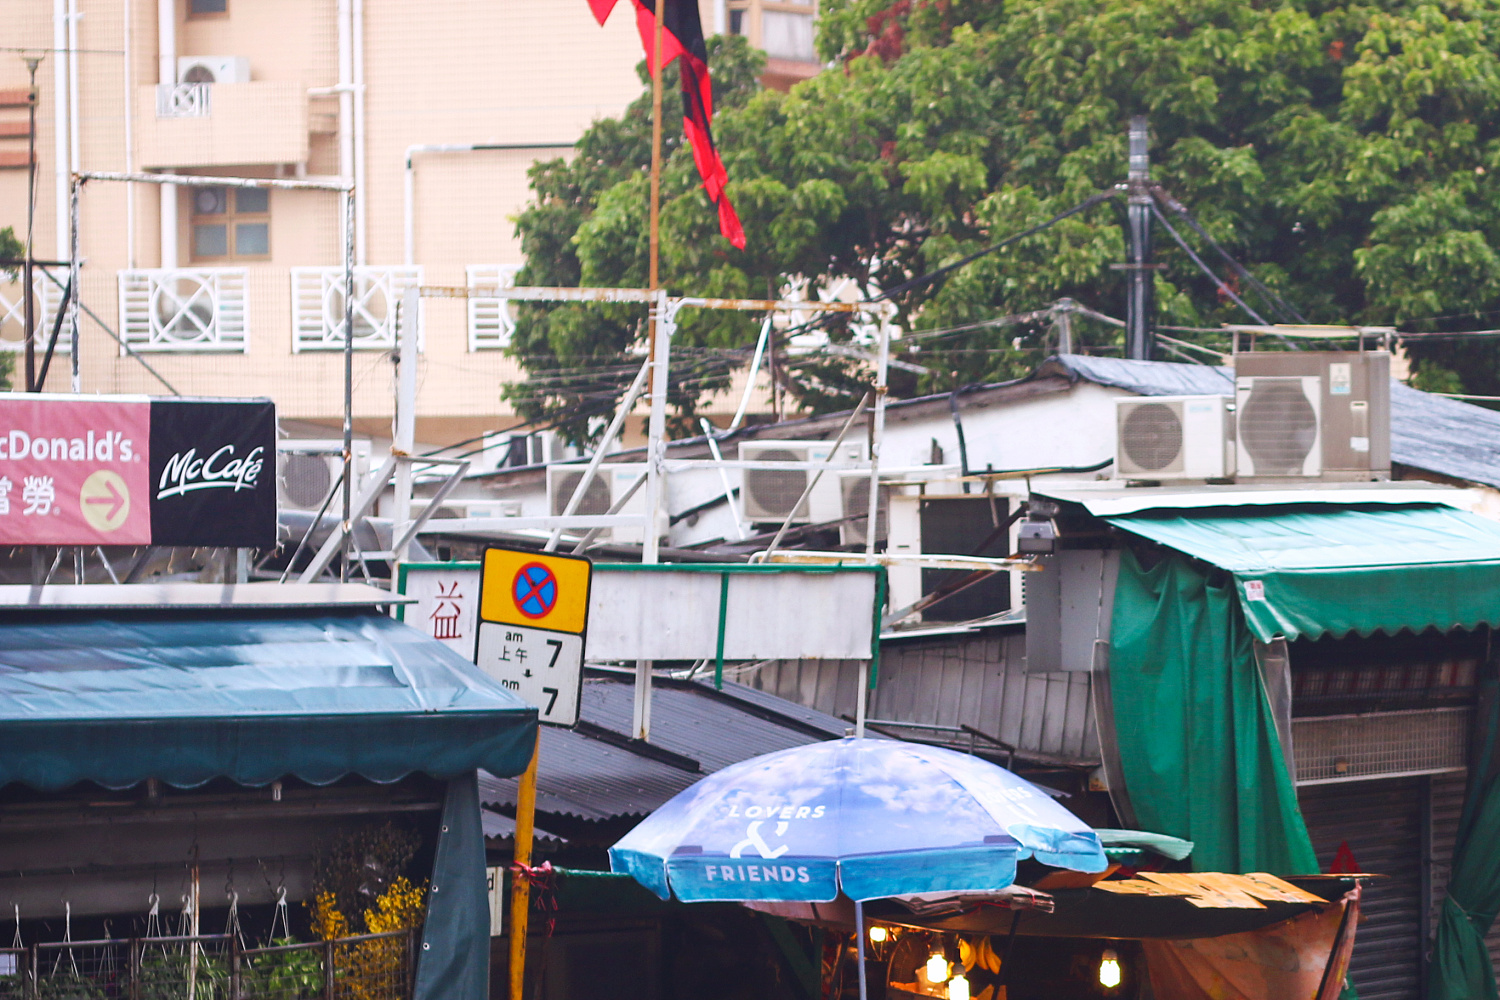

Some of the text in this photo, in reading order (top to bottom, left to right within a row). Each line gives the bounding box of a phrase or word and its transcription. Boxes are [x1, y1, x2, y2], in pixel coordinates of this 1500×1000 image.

[158, 444, 264, 496] McCafé
[429, 581, 464, 640] 益
[505, 631, 523, 643] am
[498, 645, 528, 664] 上午
[546, 639, 563, 668] 7
[542, 687, 559, 716] 7
[728, 804, 827, 820] LOVERS
[705, 865, 811, 883] FRIENDS
